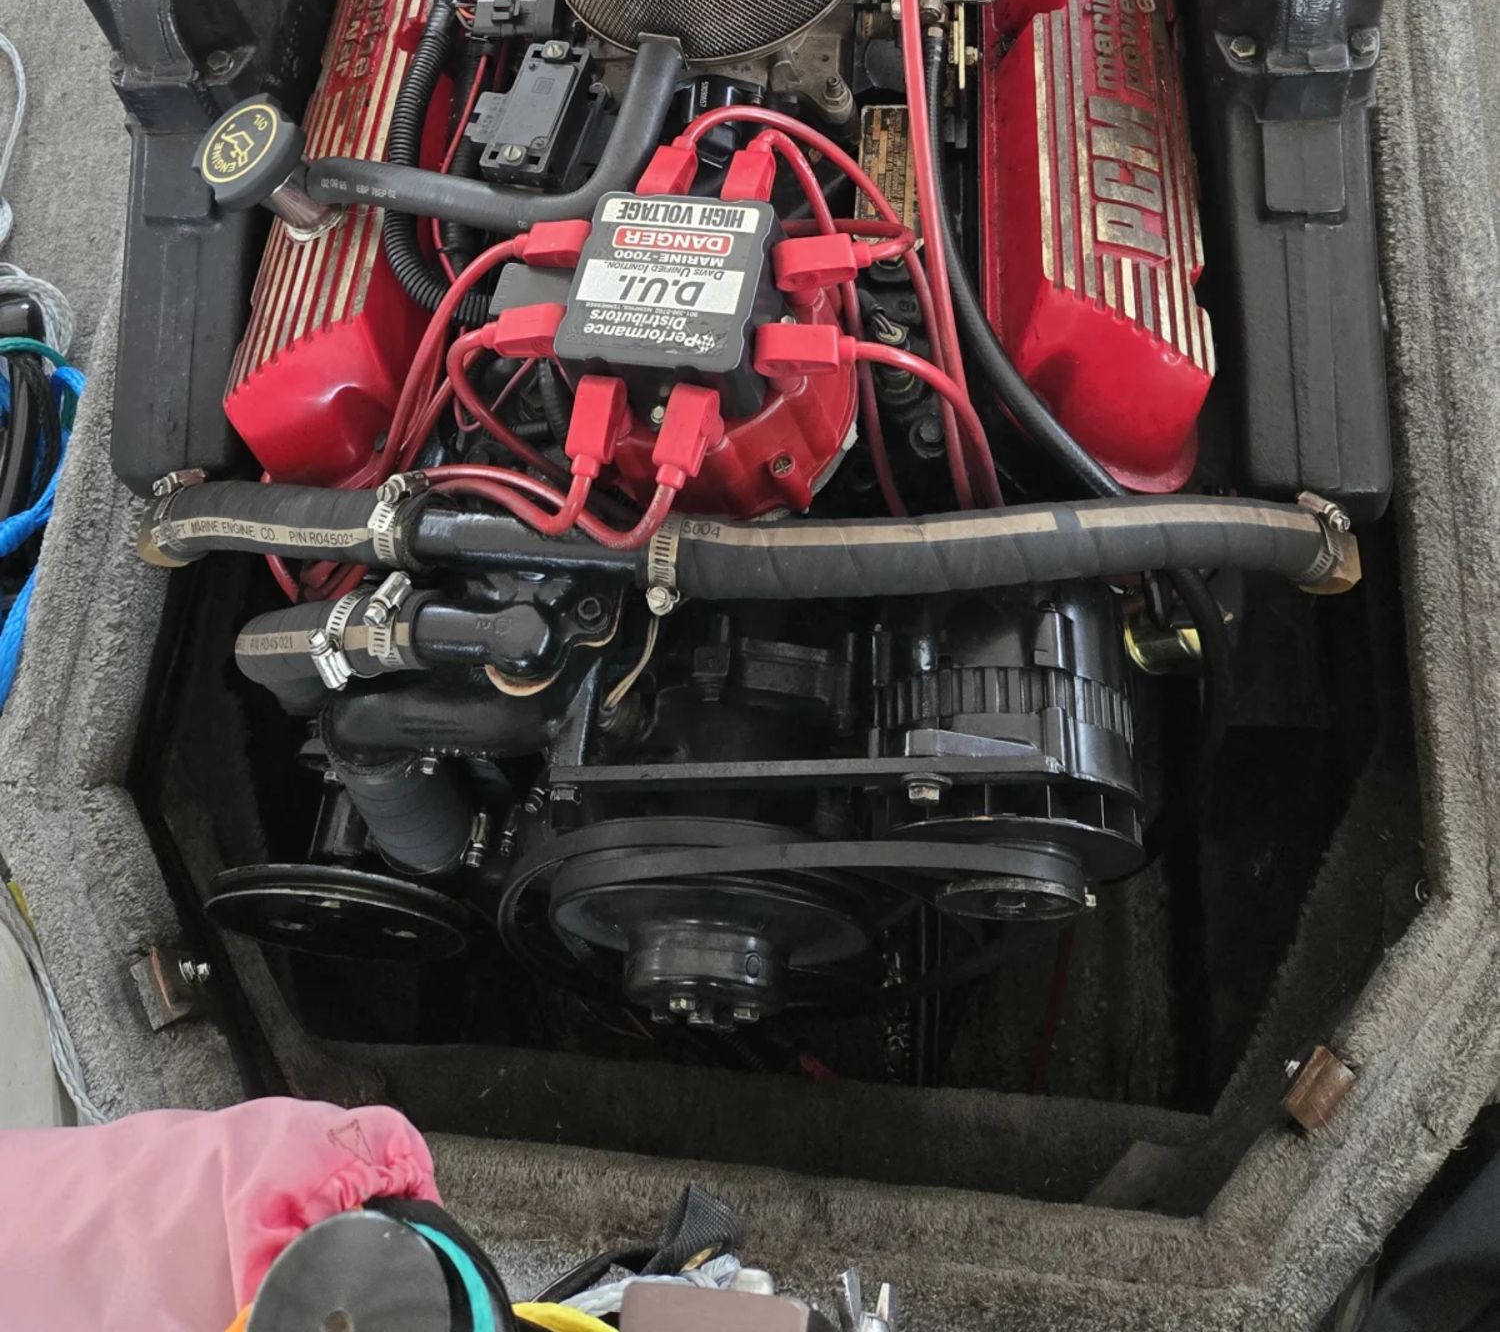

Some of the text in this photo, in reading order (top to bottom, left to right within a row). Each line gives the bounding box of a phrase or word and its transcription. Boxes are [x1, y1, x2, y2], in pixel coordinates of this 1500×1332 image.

[211, 114, 268, 173] ENGINE OIL
[1088, 96, 1168, 258] PCM
[616, 201, 746, 229] HIGH VOLTAGE
[624, 230, 724, 251] DANGER
[614, 249, 725, 267] MARINE-7000
[651, 265, 691, 278] UNIFIED
[693, 269, 725, 281] DAVIS
[618, 275, 706, 307] D.U.I.
[590, 309, 687, 331] Distributors
[583, 323, 700, 347] Performance
[191, 520, 220, 534] MARINE
[222, 522, 255, 537] ENGINE
[260, 527, 279, 541] CO.
[289, 530, 307, 544] P/N
